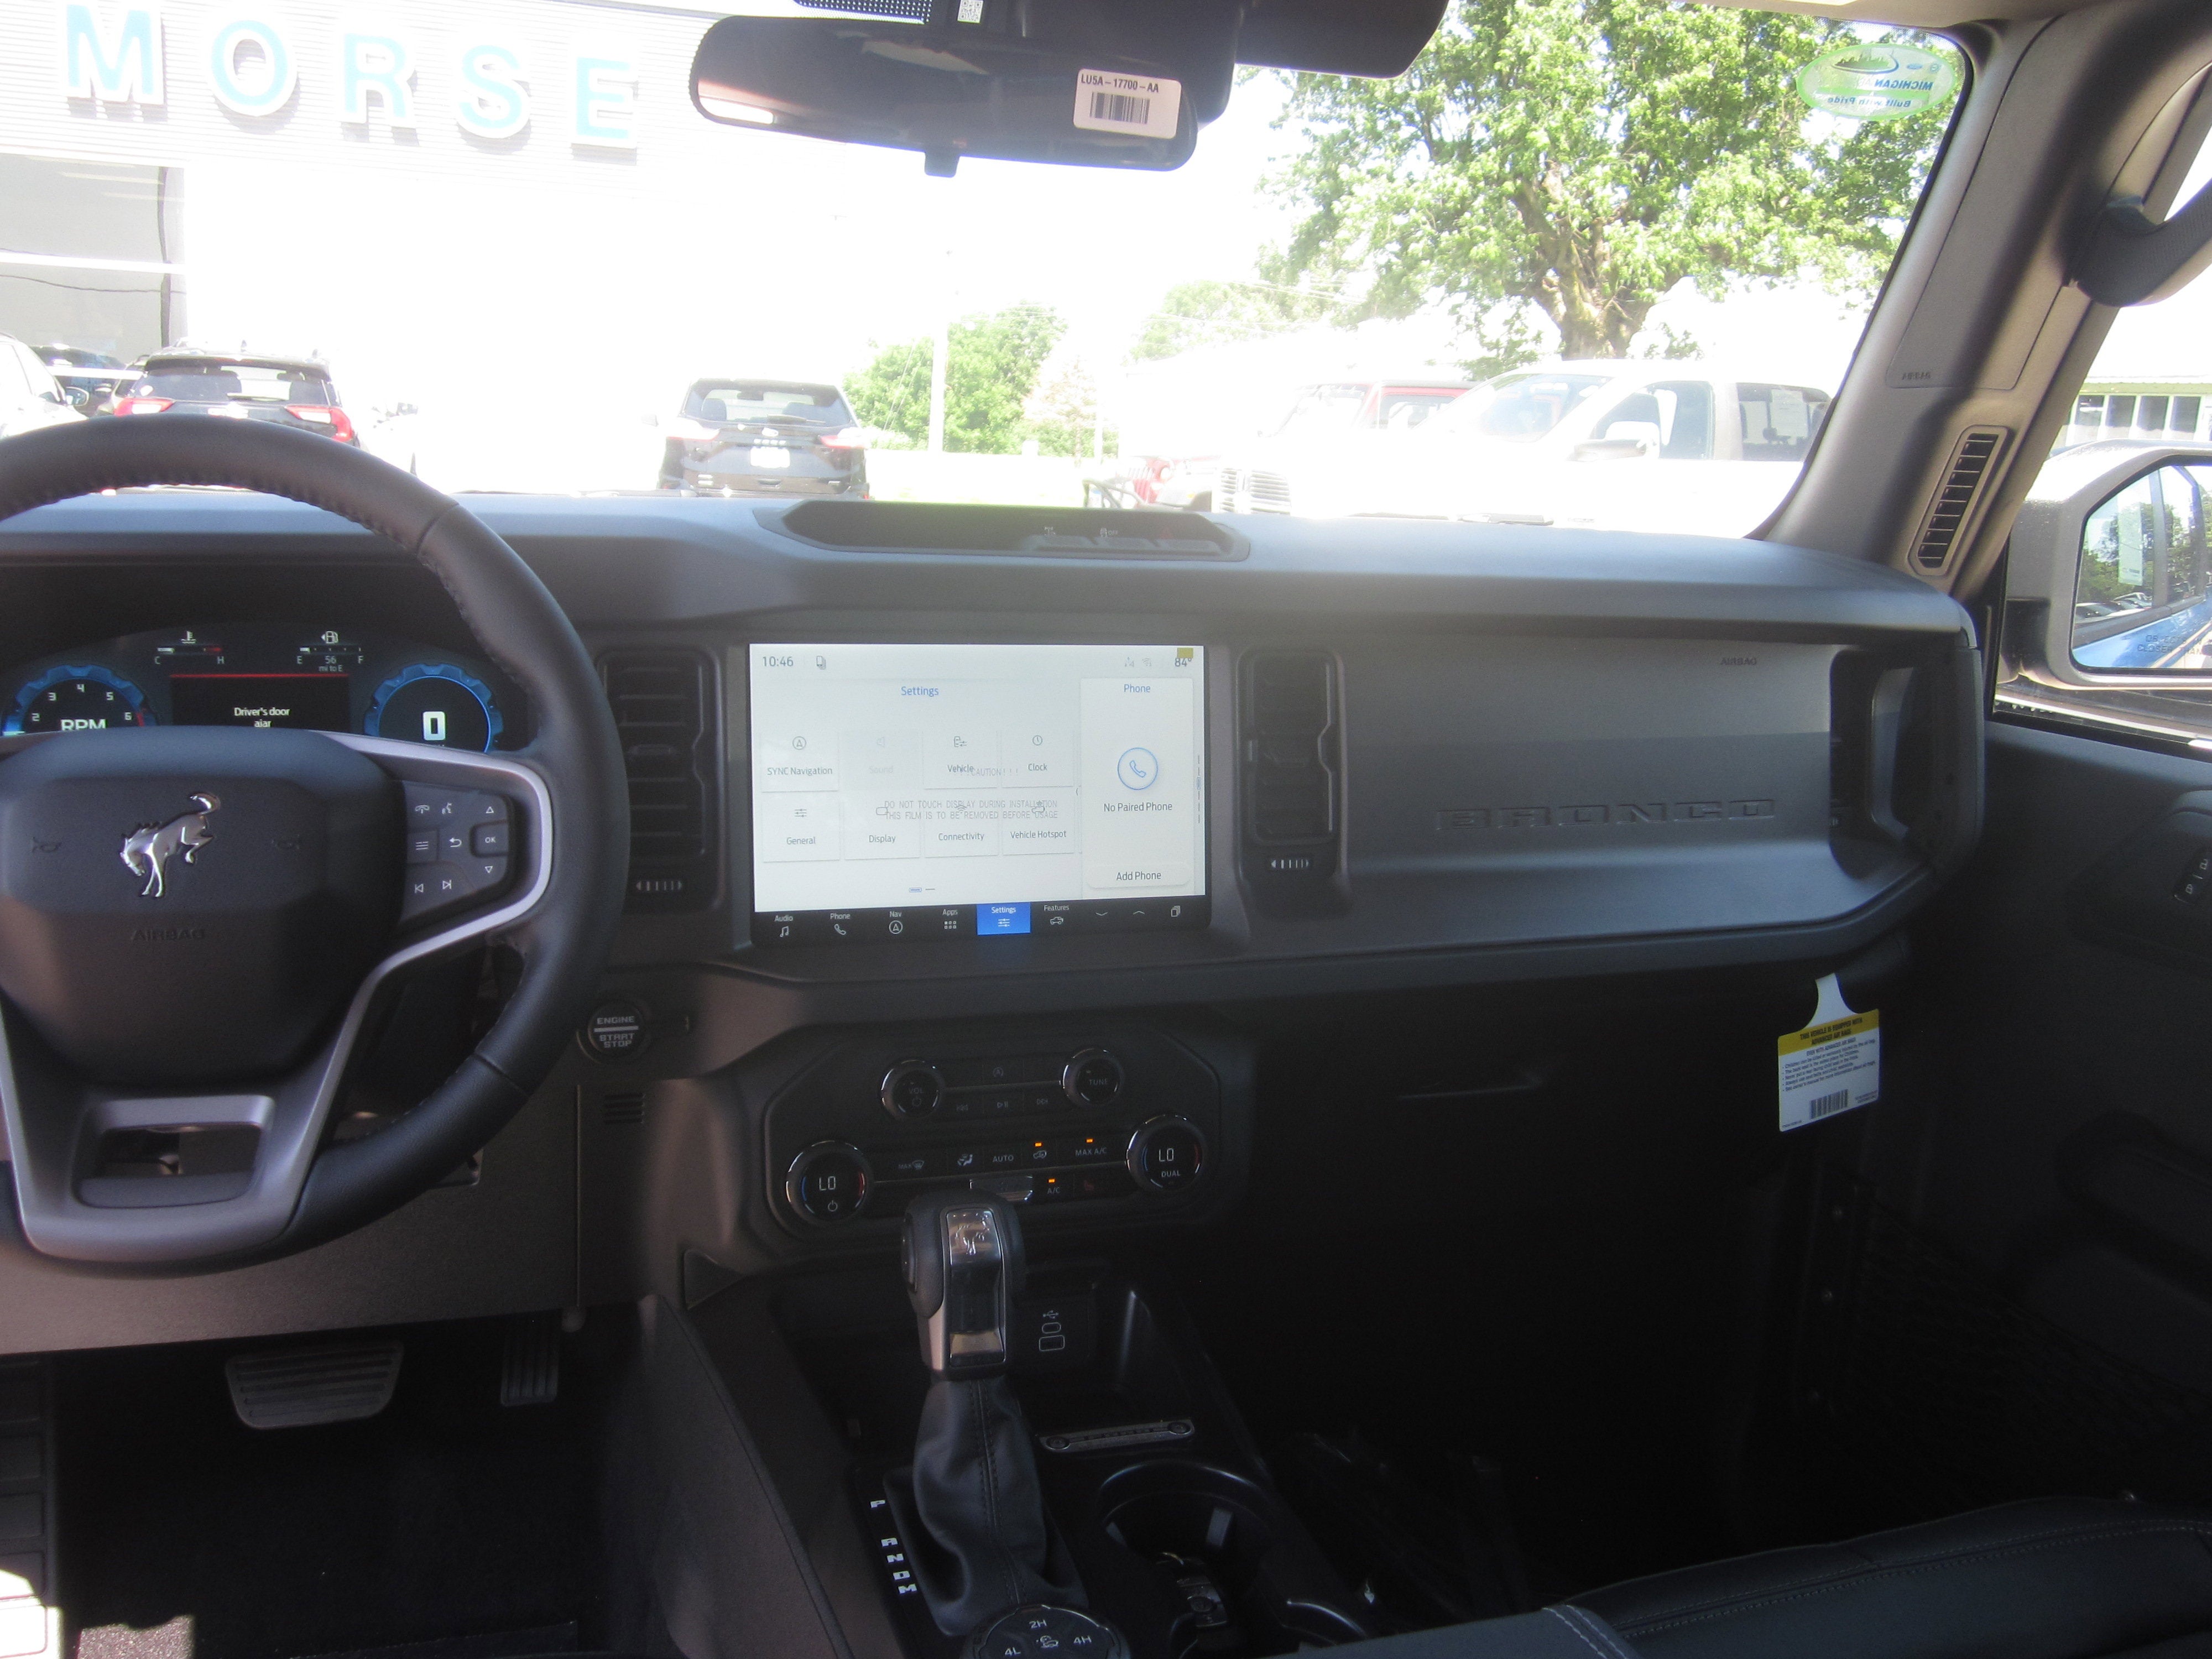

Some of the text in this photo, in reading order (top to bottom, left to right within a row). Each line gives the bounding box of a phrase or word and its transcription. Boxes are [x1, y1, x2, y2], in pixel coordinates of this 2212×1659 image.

[64, 3, 636, 143] MORSE
[154, 655, 161, 664] C
[217, 655, 225, 664] H
[297, 655, 302, 664] E
[325, 655, 336, 664] 56
[358, 655, 363, 664] F
[763, 655, 794, 667] 10:46
[76, 684, 85, 692] 4
[901, 686, 940, 697] Settings
[1124, 684, 1151, 693] Phone
[48, 692, 56, 701] 3
[106, 692, 114, 701] 5
[124, 712, 132, 721] 6
[234, 707, 290, 717] Driver's door
[32, 713, 40, 722] 2
[60, 719, 107, 731] RPM
[423, 711, 446, 741] 0
[767, 766, 833, 776] SYNC Navigation
[947, 764, 974, 773] Vehicle
[1028, 763, 1047, 771] Clock
[918, 800, 942, 808] TOUCH
[1104, 802, 1173, 812] No Paired Phone
[885, 811, 901, 820] THIS
[905, 811, 922, 820] FILM
[926, 811, 932, 820] IS
[964, 811, 999, 819] REMOVED
[1003, 811, 1030, 819] BEFORE
[1035, 810, 1058, 819] USAGE
[1436, 799, 1775, 830] BRONCO
[869, 834, 896, 845] Display
[938, 831, 984, 842] Connectivity
[1010, 830, 1067, 840] Vehicle Hotspot
[786, 836, 816, 845] General
[1116, 871, 1161, 881] Add Phone
[942, 909, 958, 917] Apps
[991, 906, 1016, 915] Settings
[830, 912, 851, 921] Phone
[597, 1016, 635, 1025] ENGINE
[599, 1033, 635, 1041] START
[1159, 1148, 1174, 1162] LO
[819, 1176, 836, 1191] LO
[886, 1553, 904, 1563] N
[898, 1583, 917, 1594] M
[1029, 1619, 1047, 1629] 2H
[1073, 1636, 1093, 1645] 4H
[1004, 1647, 1021, 1656] 4L
